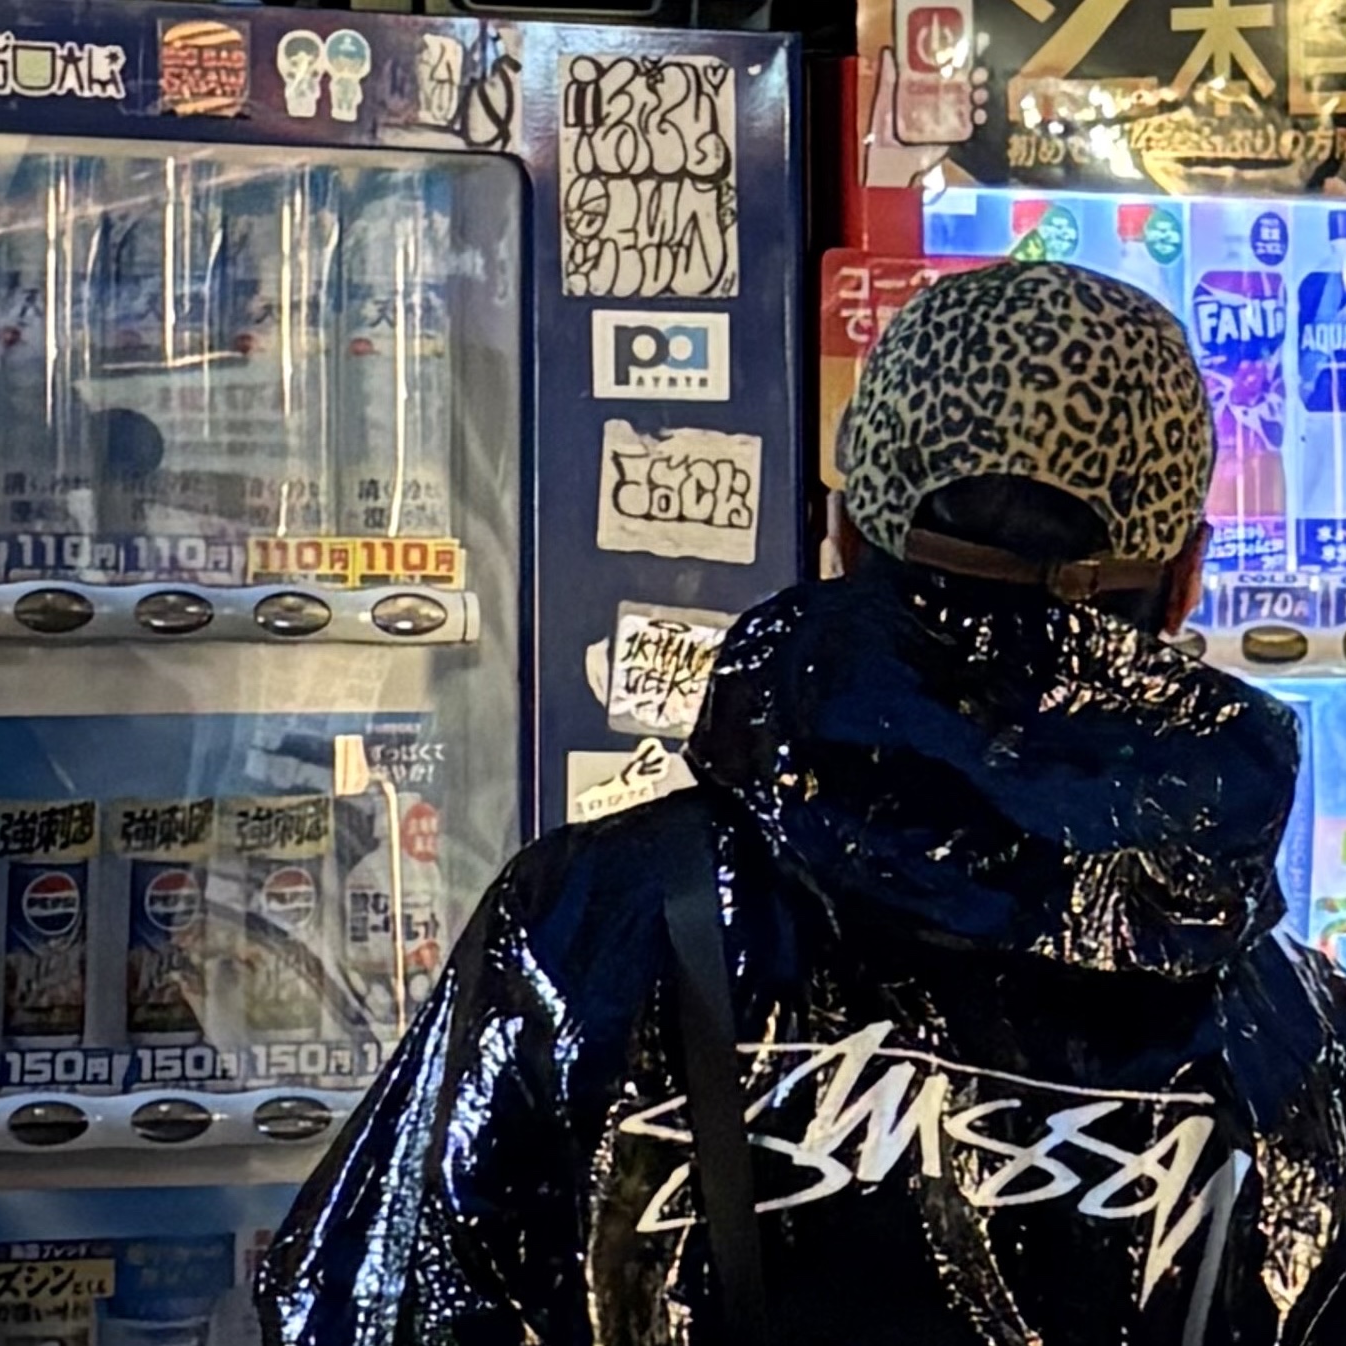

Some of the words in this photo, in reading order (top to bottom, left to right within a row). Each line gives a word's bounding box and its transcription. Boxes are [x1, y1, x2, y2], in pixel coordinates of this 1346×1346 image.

[133, 536, 233, 570] 110円
[254, 541, 350, 573] 110円
[361, 541, 456, 574] 110円
[4, 1050, 110, 1084] 150円
[137, 1048, 238, 1082] 150円
[255, 1043, 353, 1077] 150円
